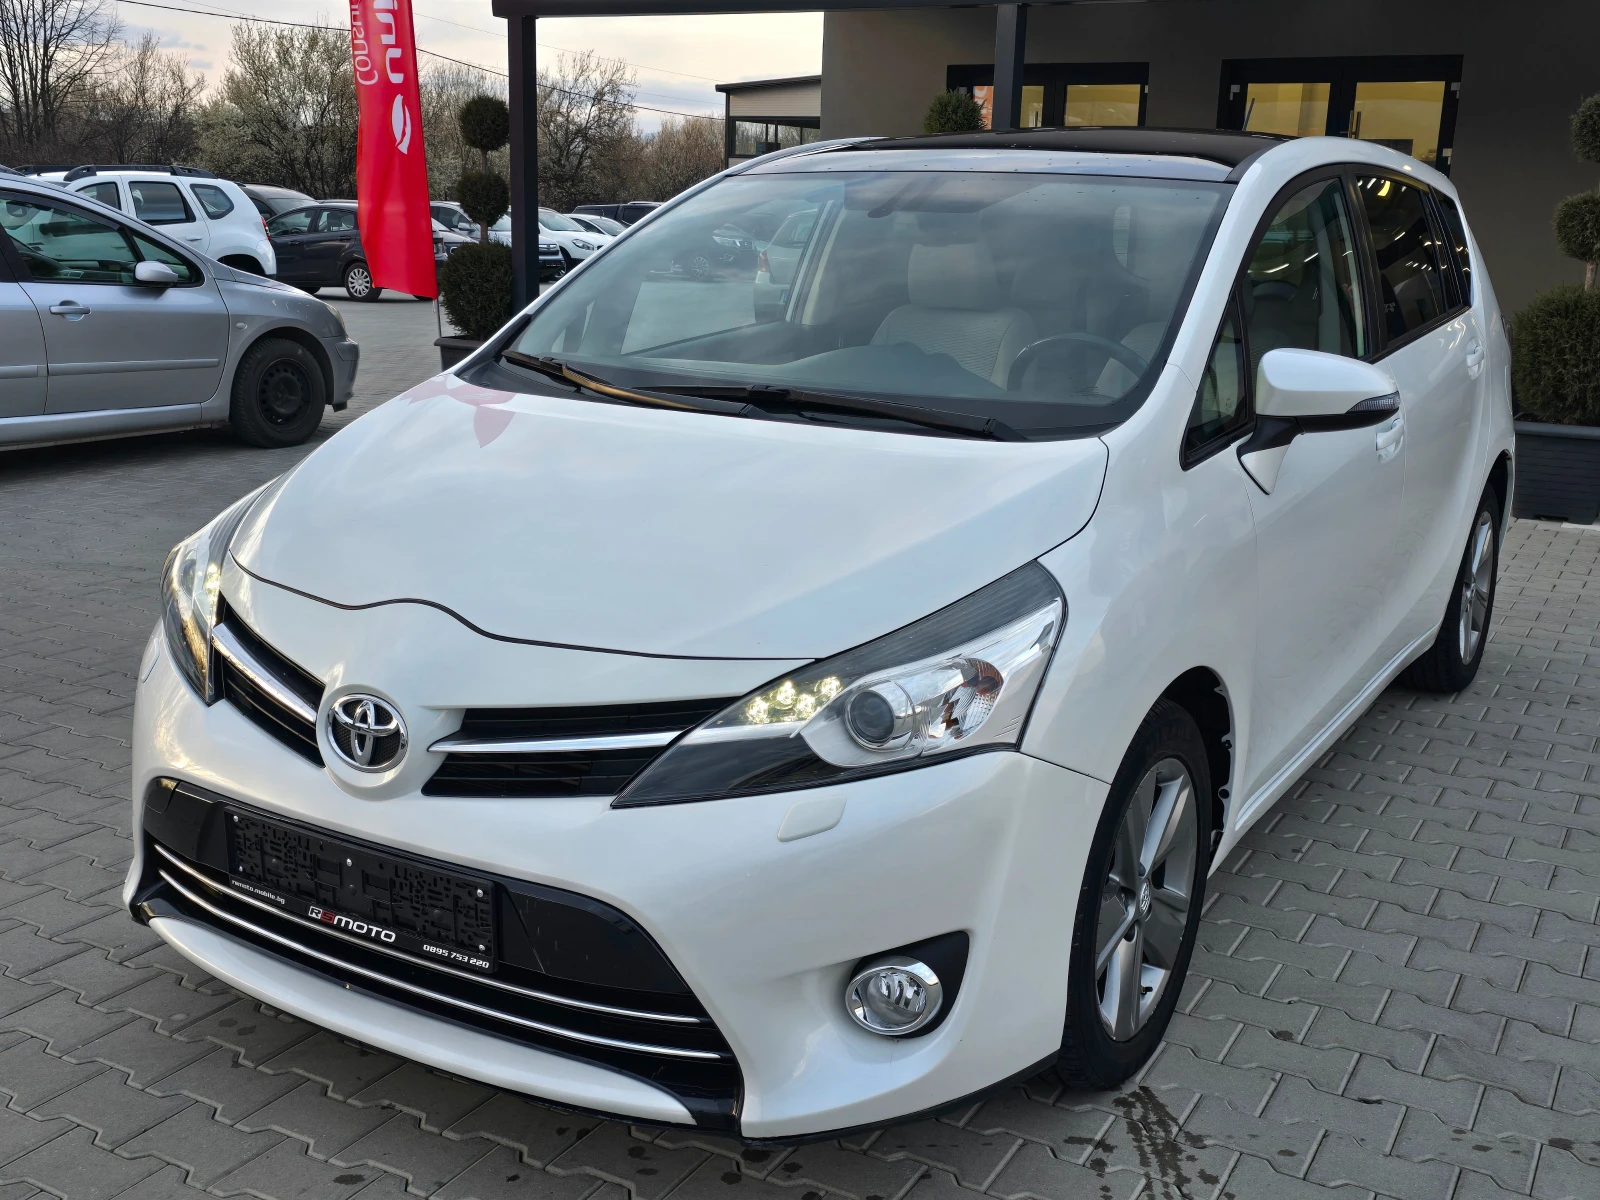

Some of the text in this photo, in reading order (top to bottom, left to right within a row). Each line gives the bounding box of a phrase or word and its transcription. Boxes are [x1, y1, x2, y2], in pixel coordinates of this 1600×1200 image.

[423, 944, 490, 969] 0895 753 220
